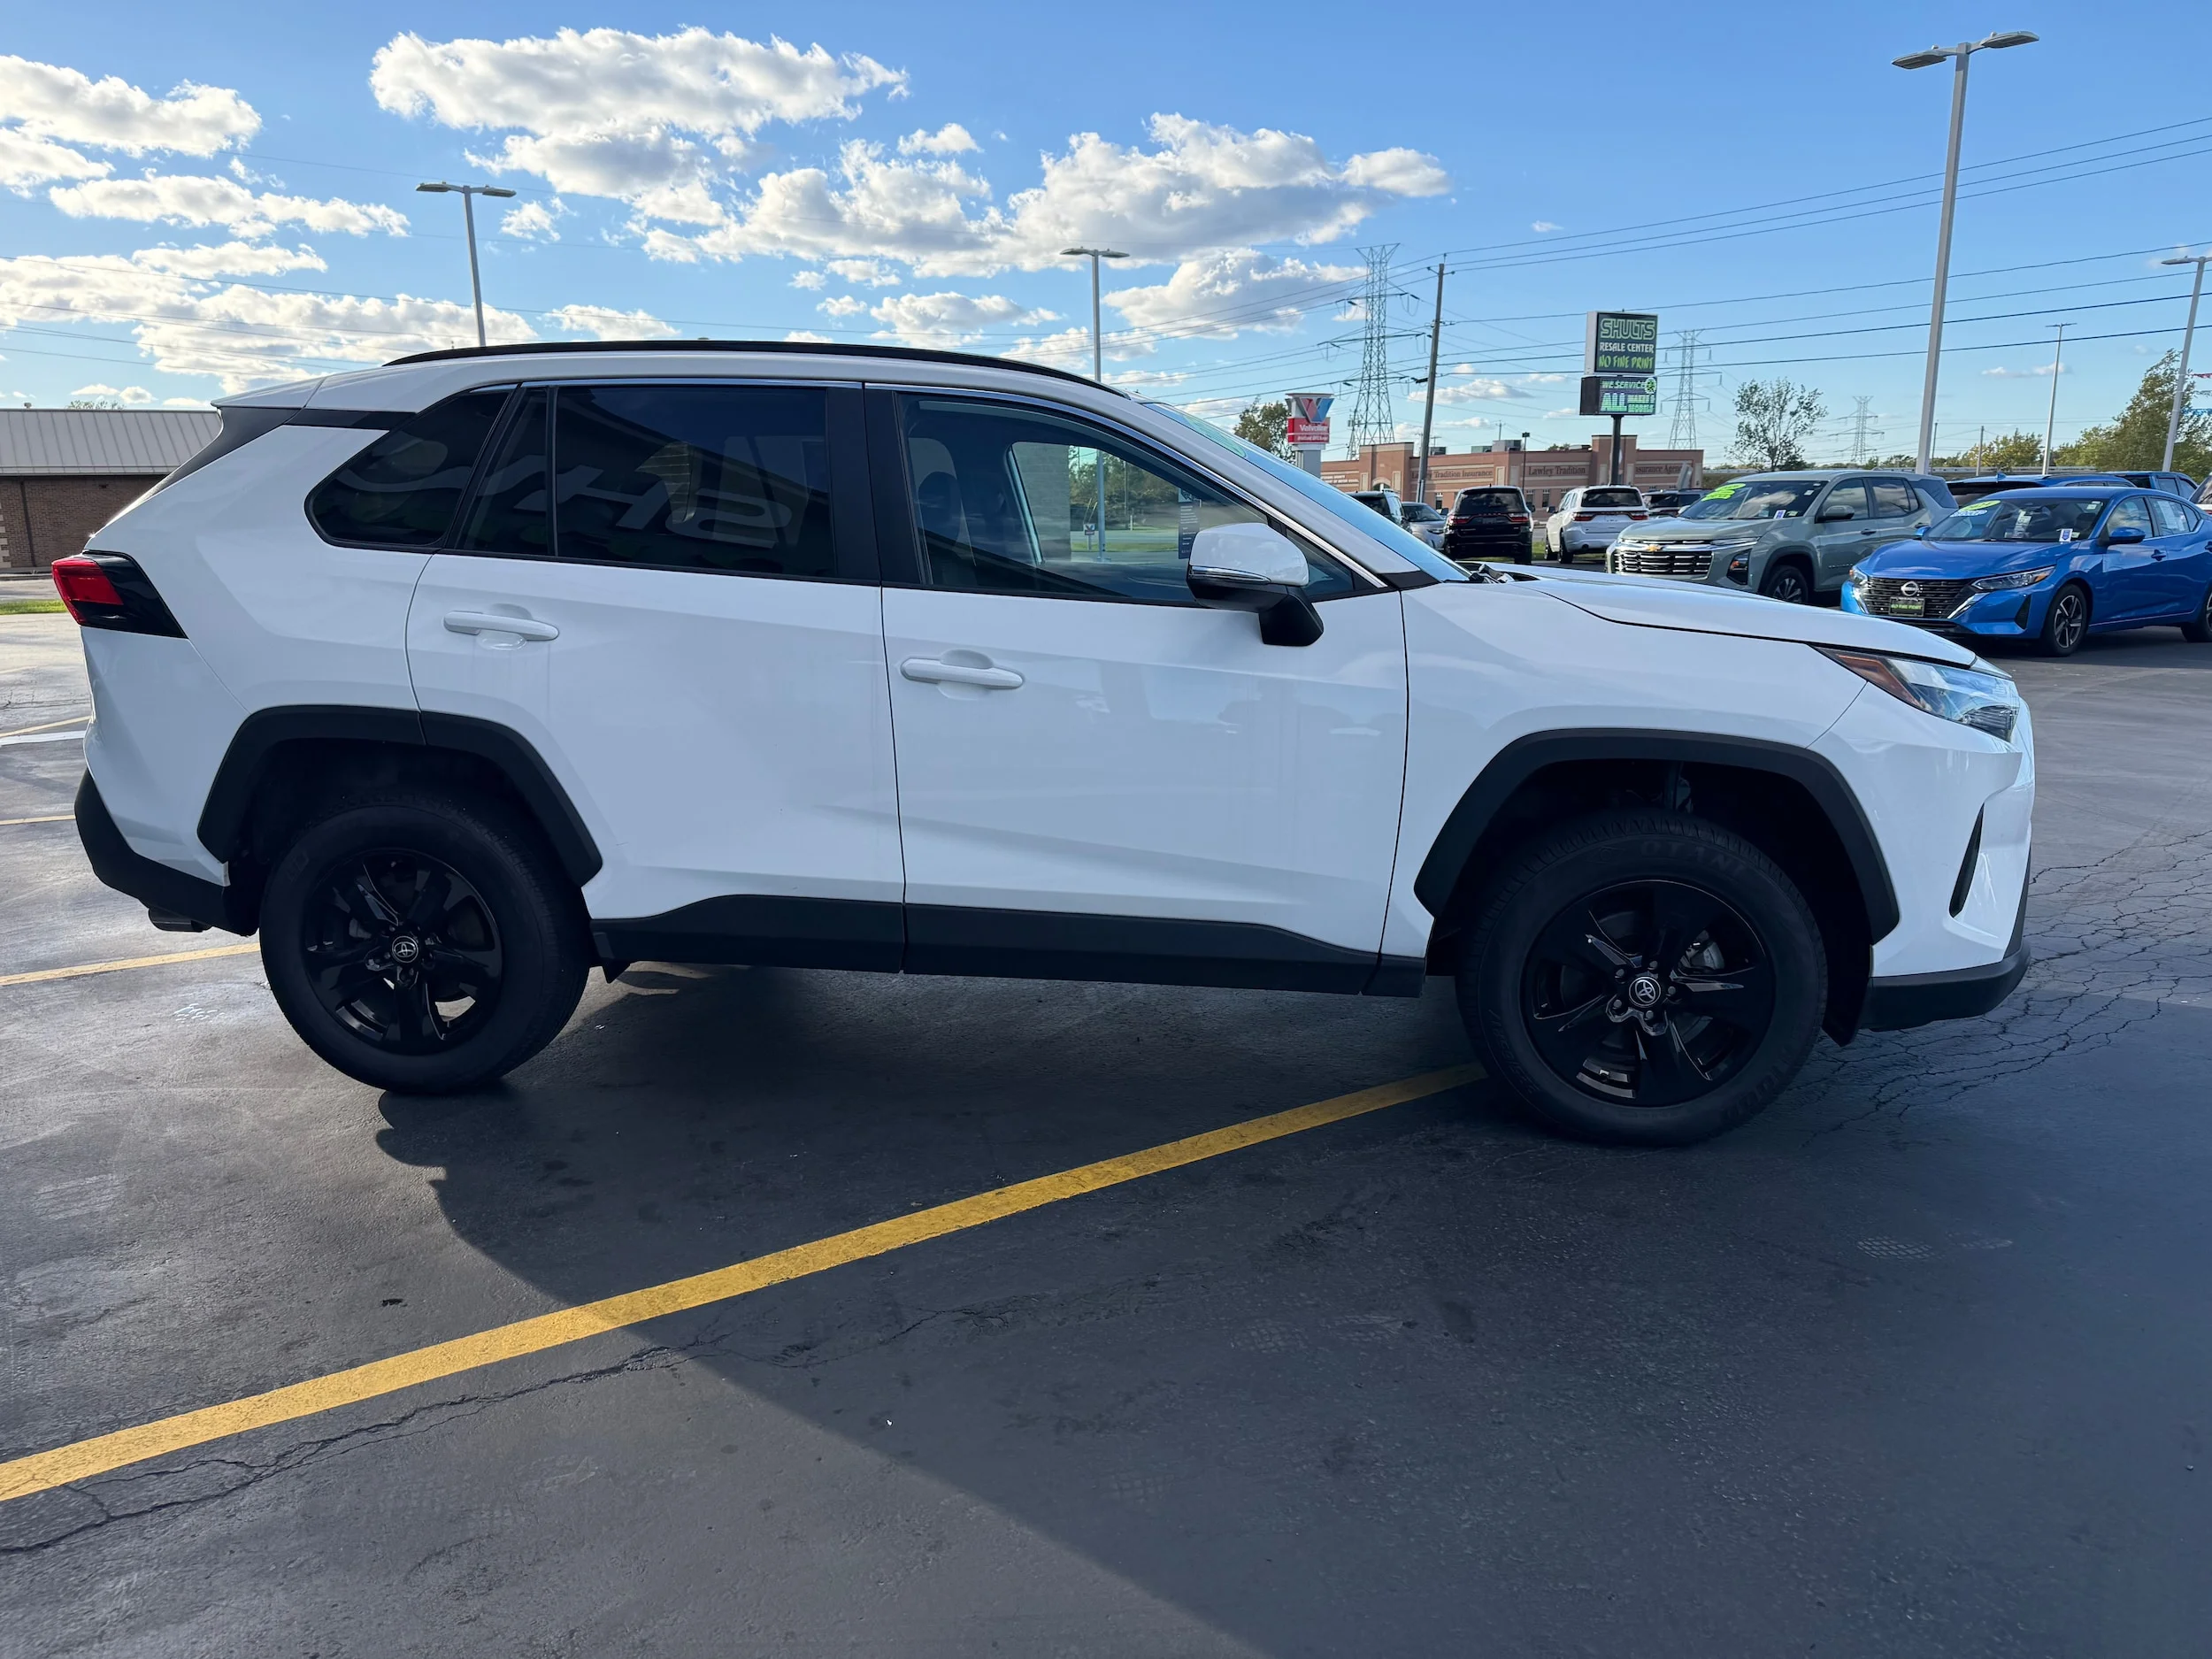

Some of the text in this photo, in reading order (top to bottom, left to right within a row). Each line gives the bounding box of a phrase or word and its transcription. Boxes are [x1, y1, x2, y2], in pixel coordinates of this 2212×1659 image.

[1600, 318, 1655, 341] SHULTS
[1599, 342, 1655, 353] RESALE CENTER
[1599, 355, 1654, 369] NO FINE PRINT
[1601, 392, 1628, 411] ALL
[1555, 465, 1586, 475] Tradition
